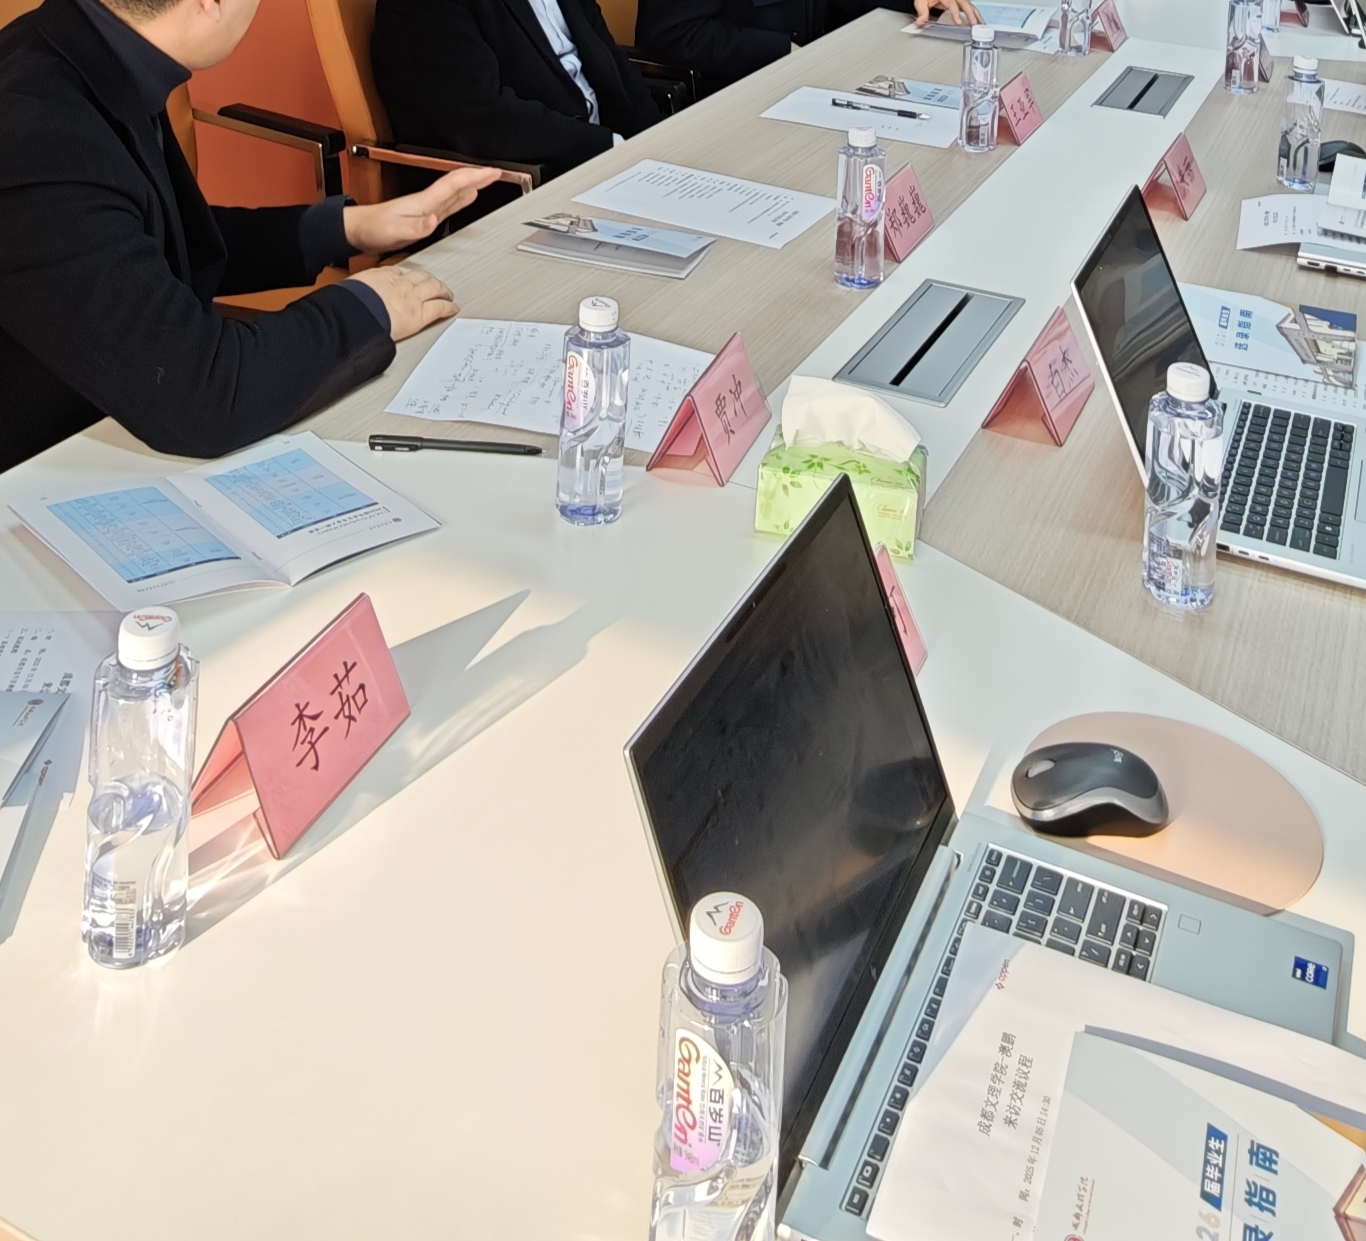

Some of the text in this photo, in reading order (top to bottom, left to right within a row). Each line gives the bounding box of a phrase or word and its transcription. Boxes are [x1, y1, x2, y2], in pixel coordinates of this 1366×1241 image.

[290, 660, 370, 772] 李茹
[708, 1087, 725, 1143] 百岁山
[1202, 1136, 1226, 1197] 届毕业生
